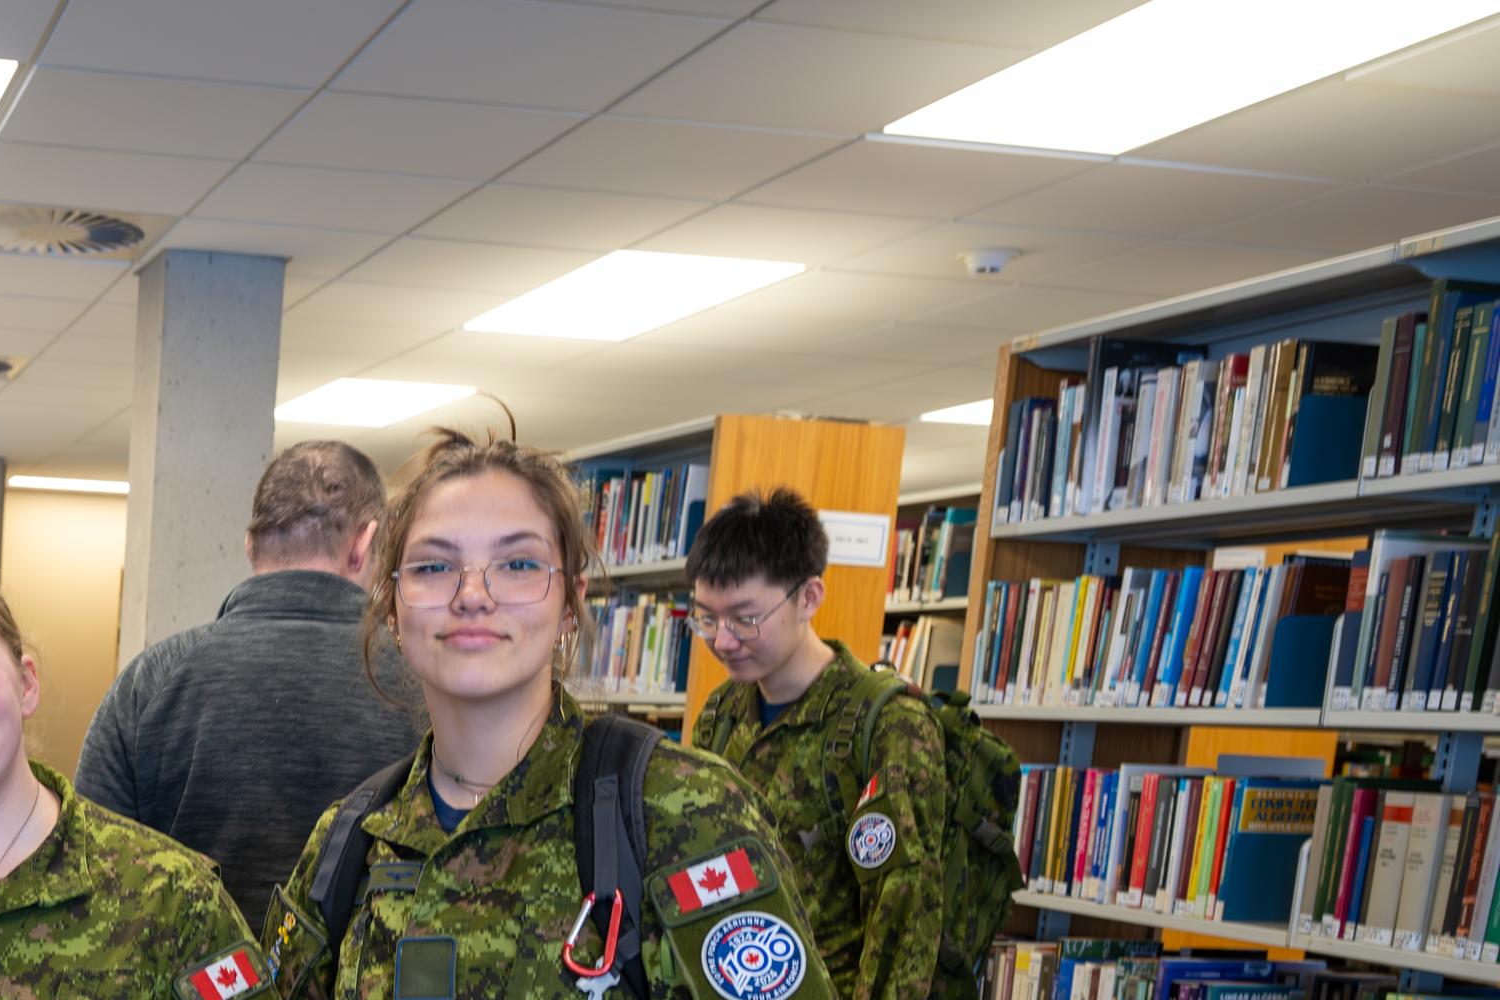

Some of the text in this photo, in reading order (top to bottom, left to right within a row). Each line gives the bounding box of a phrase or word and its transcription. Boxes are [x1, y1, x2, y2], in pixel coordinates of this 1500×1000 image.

[707, 931, 724, 958] FORCE
[728, 931, 754, 948] 1924
[754, 969, 778, 988] 2024
[773, 983, 789, 999] AIR
[785, 959, 799, 986] FORCE
